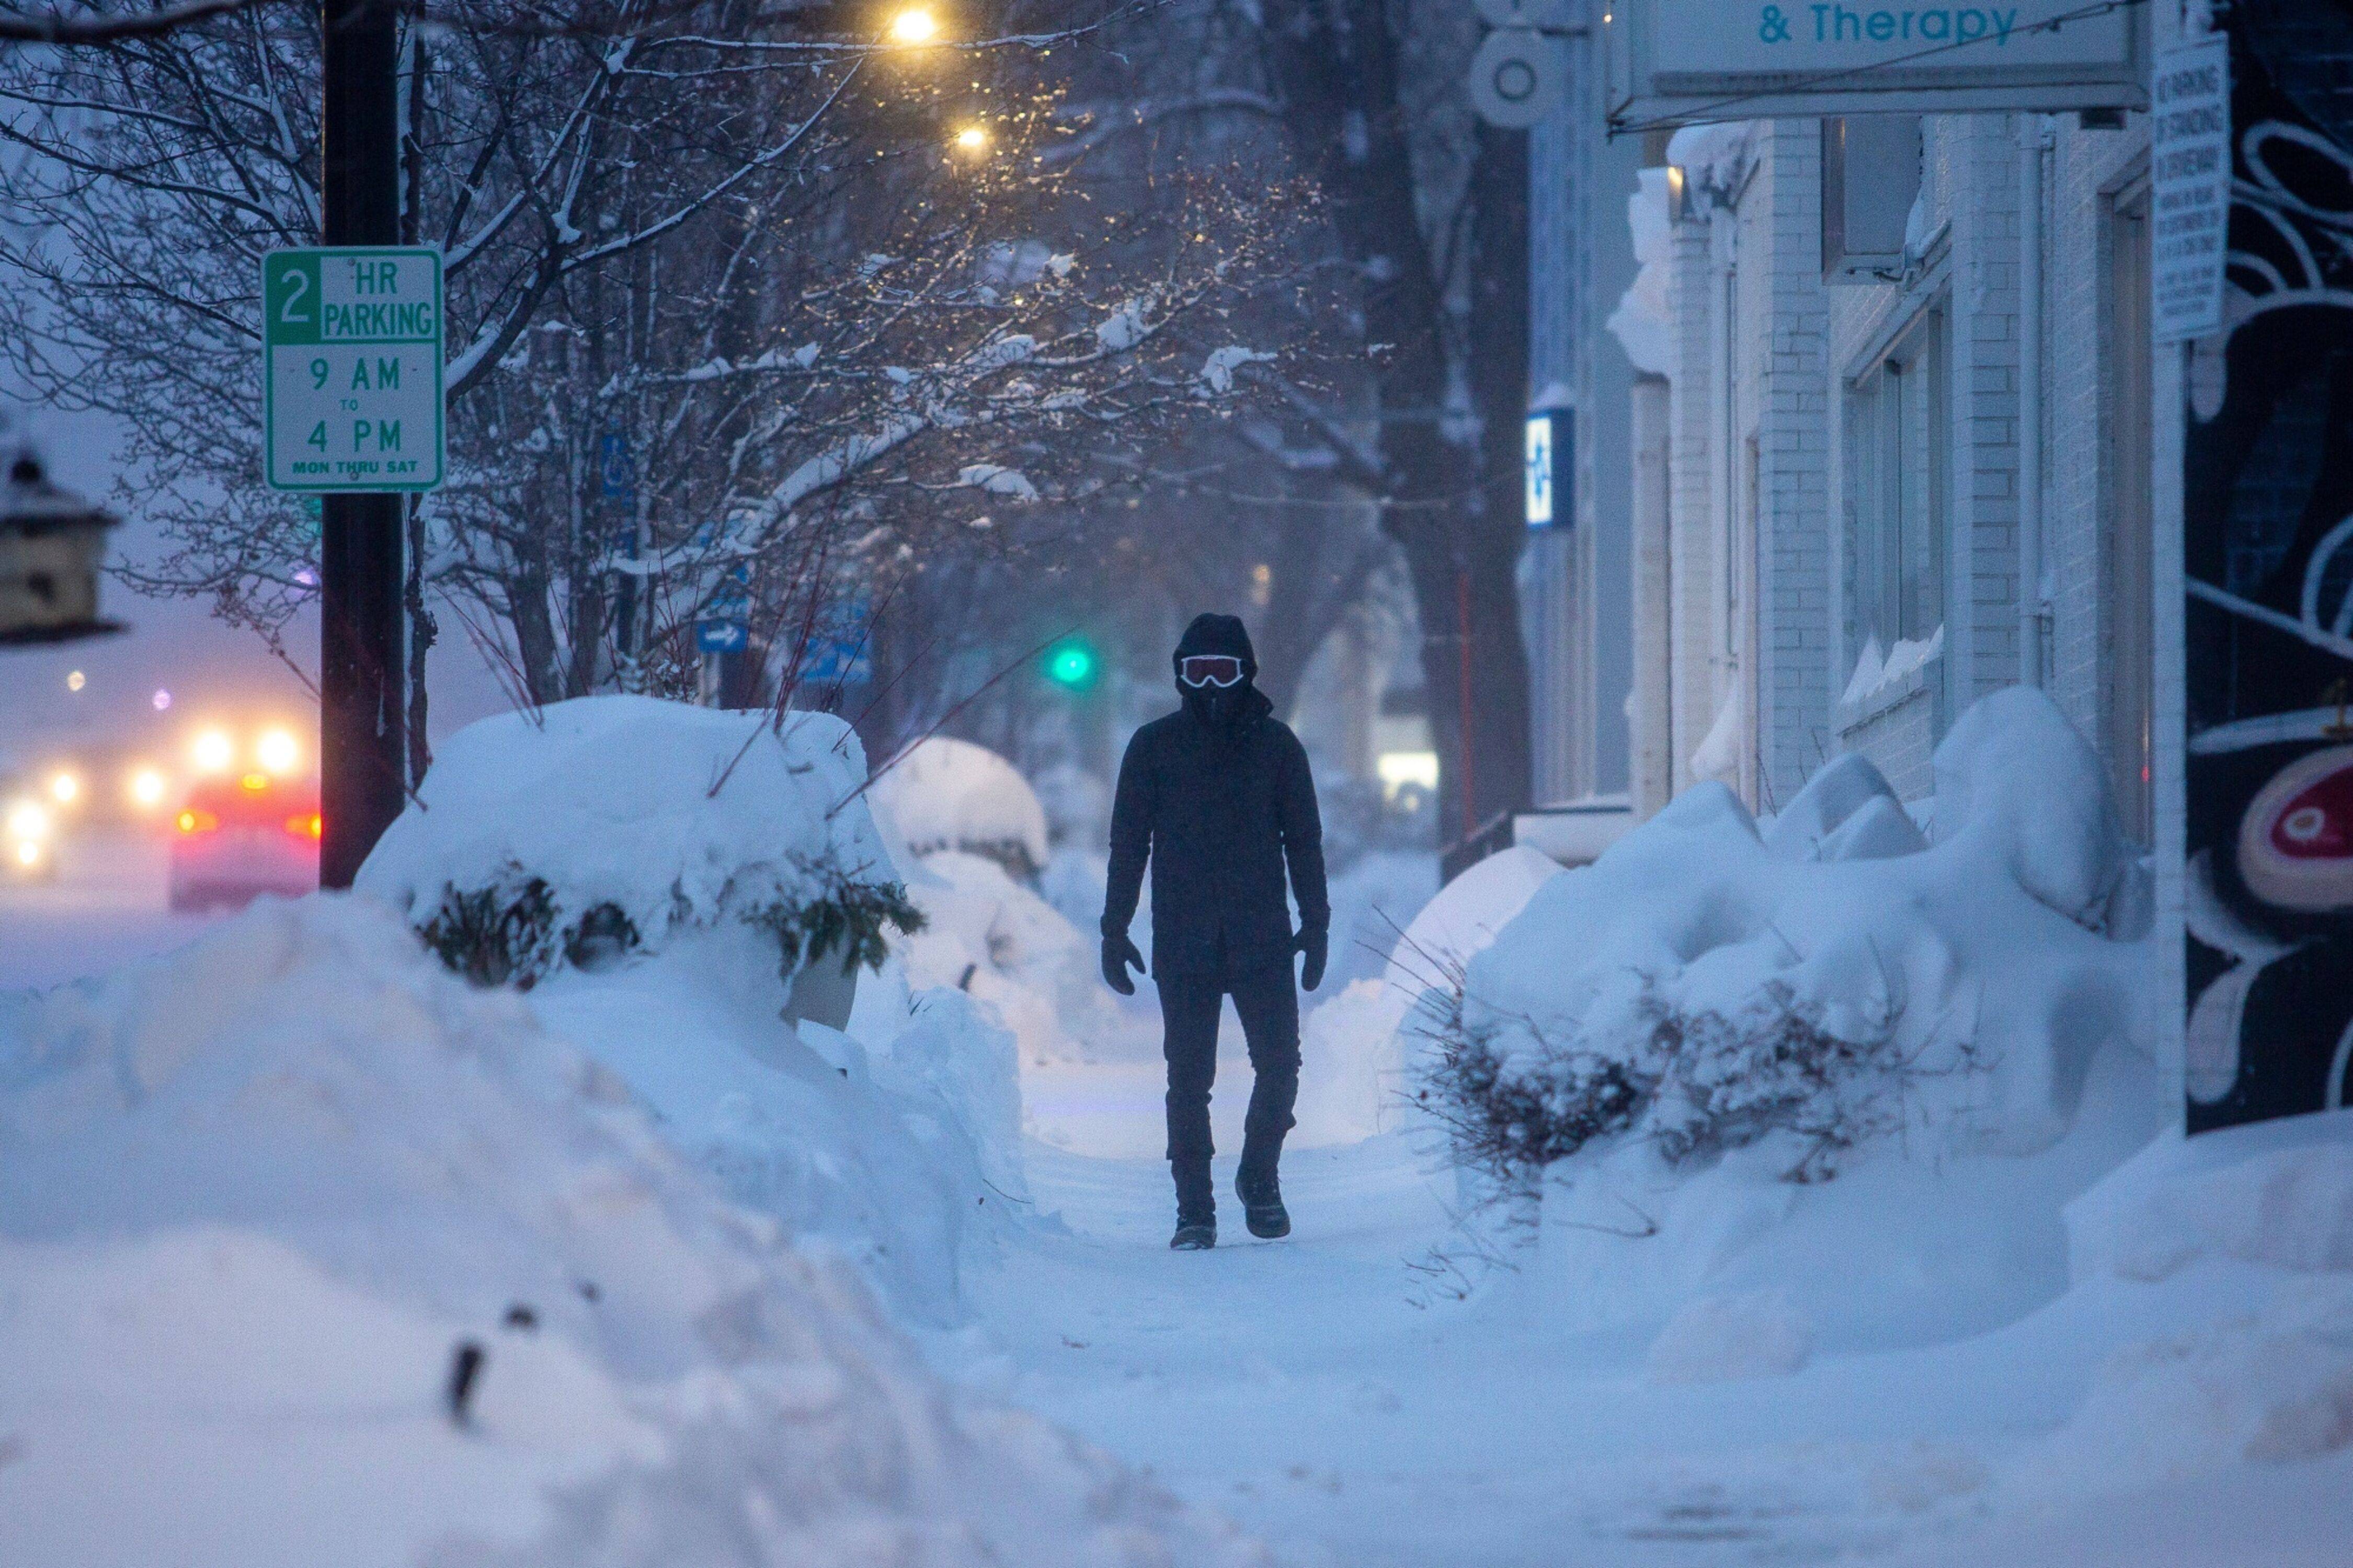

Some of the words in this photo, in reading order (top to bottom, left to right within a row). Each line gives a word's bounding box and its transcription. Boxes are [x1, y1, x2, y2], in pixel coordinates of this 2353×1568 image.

[1758, 4, 1792, 44] &
[1810, 3, 2018, 47] Therapy
[356, 262, 398, 294] HR
[281, 269, 310, 323] 2
[324, 302, 433, 337] PARKING
[310, 358, 330, 391] 9
[351, 357, 399, 391] AM
[340, 399, 359, 411] TO
[307, 419, 327, 452] 4
[354, 419, 401, 452] PM
[292, 462, 329, 474] MON
[336, 461, 380, 474] THRU
[386, 461, 417, 473] SAT
